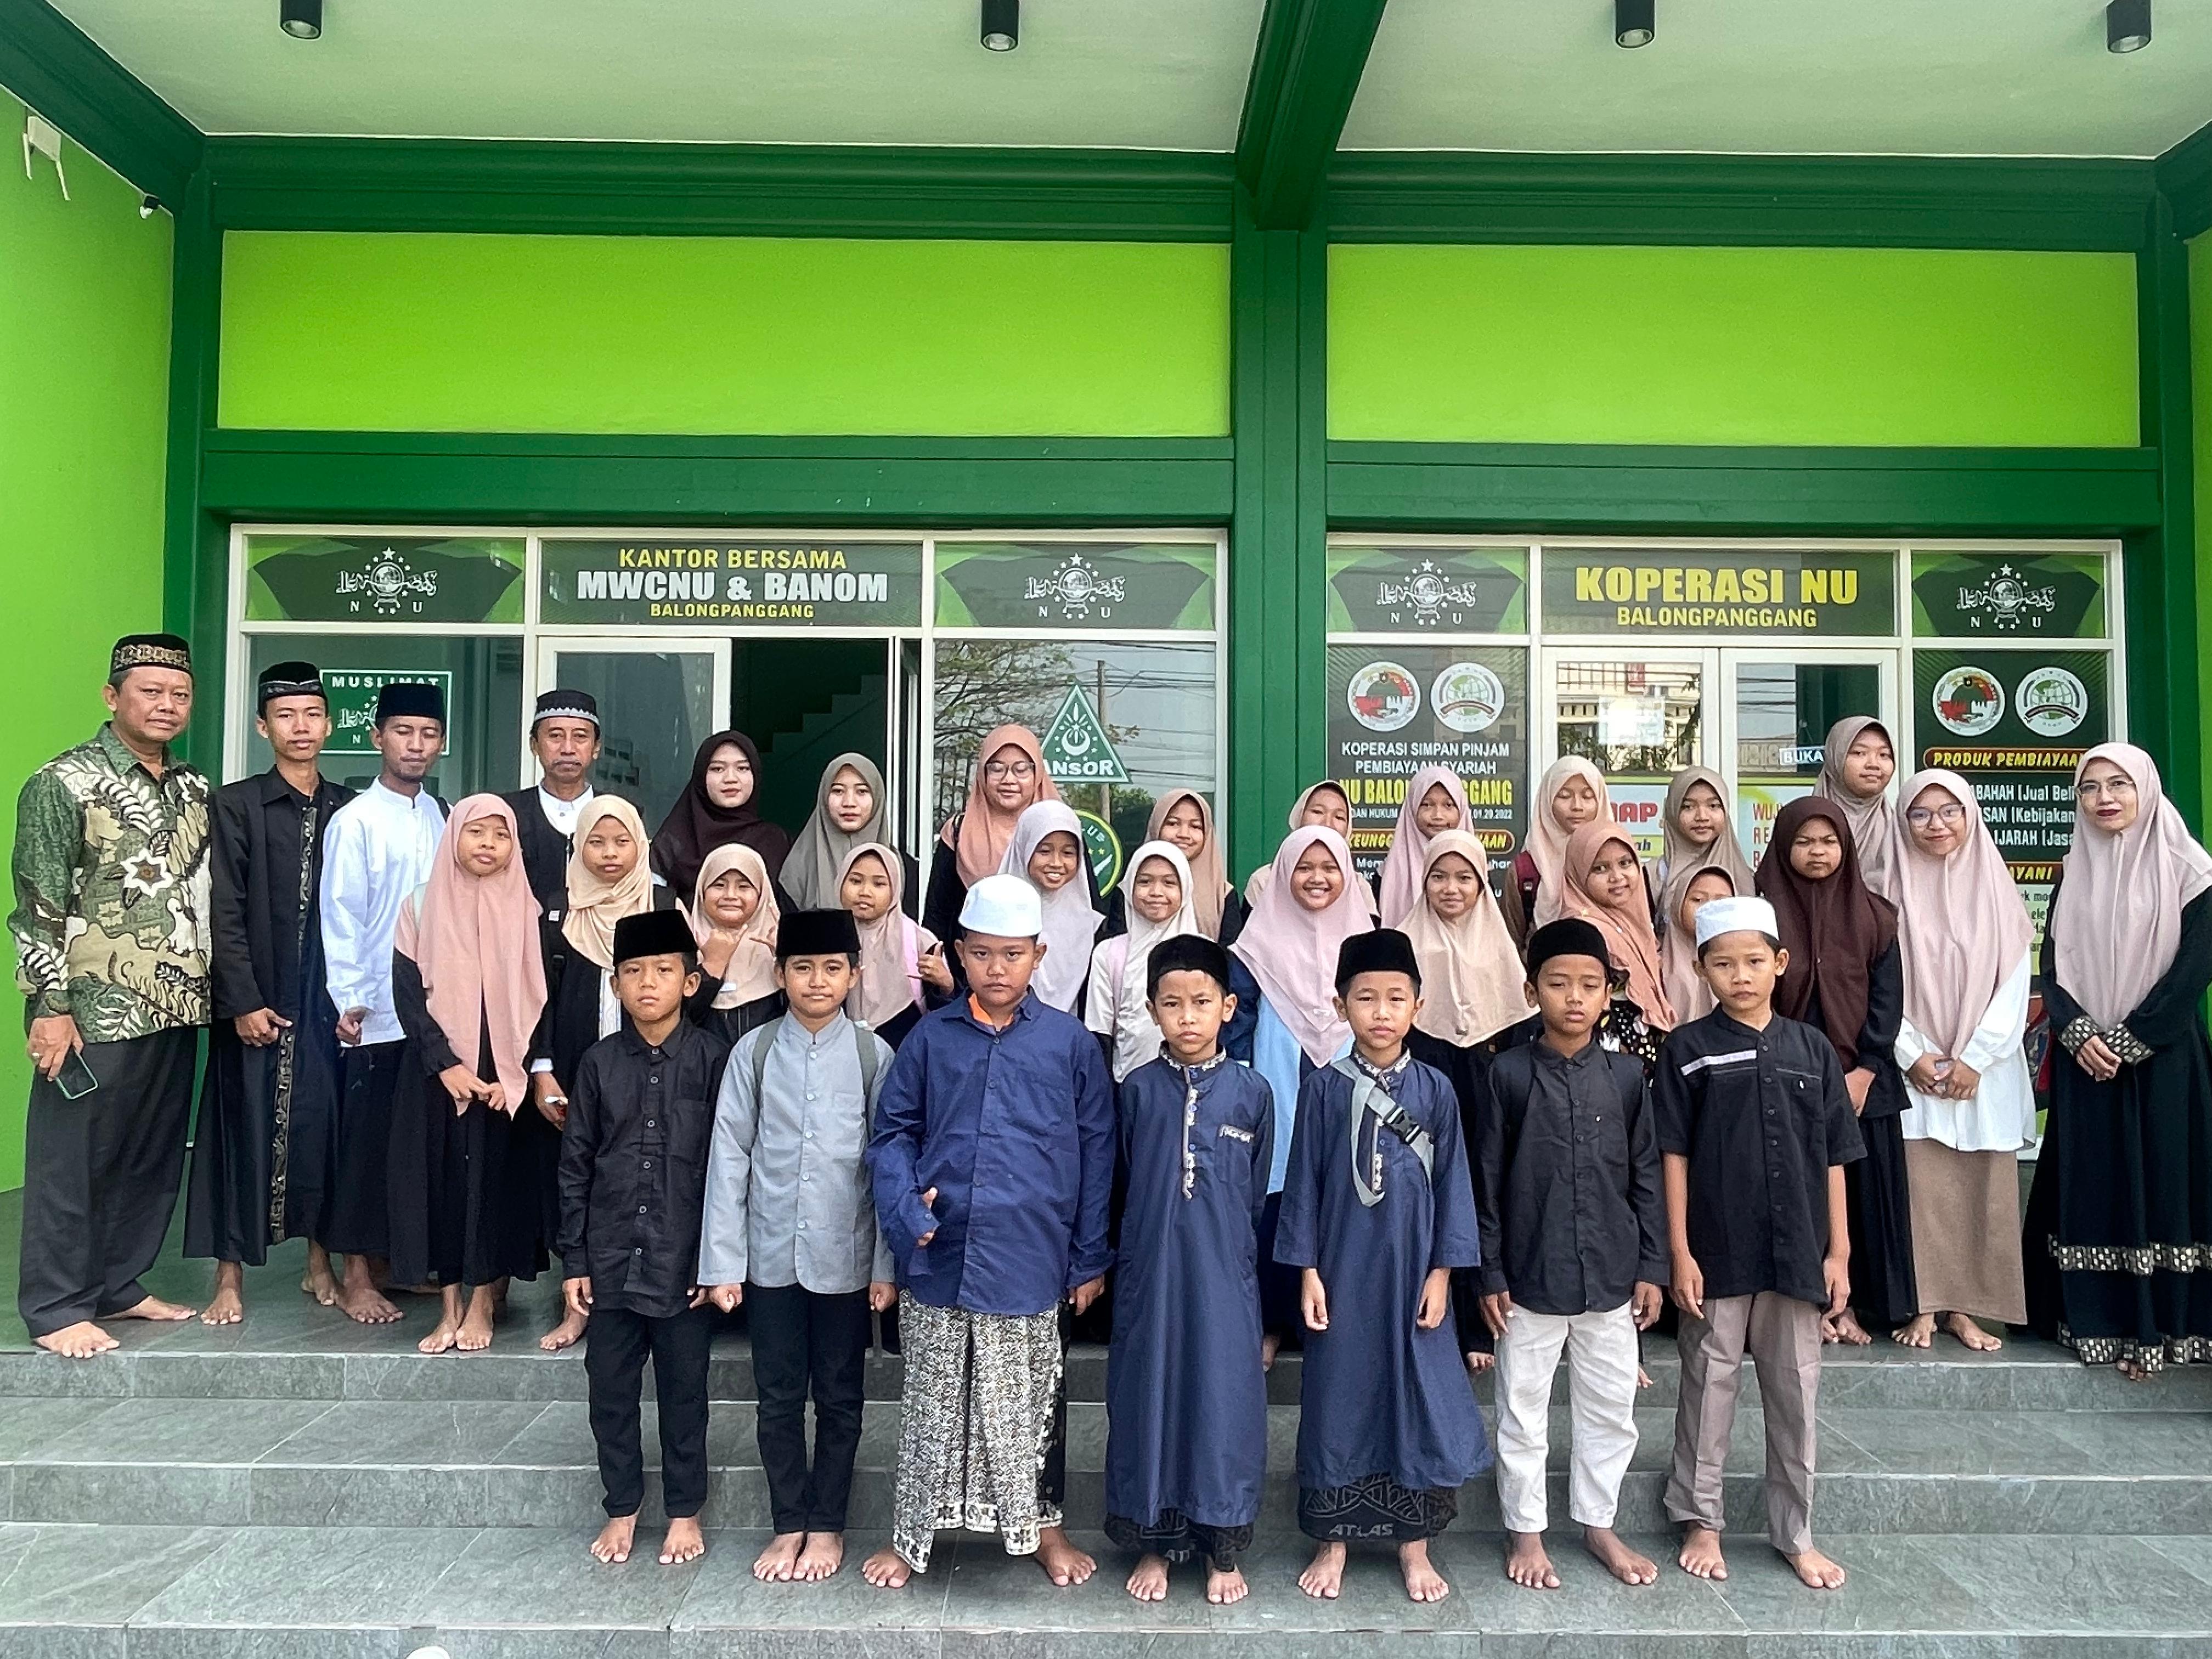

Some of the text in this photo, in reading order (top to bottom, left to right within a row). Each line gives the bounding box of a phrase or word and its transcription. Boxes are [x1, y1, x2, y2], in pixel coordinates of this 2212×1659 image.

[619, 549, 847, 569] KANTOR BERSAMA
[577, 571, 888, 602] MWCNU & BANOM
[1576, 566, 1858, 604] KOPERASI NU
[350, 600, 422, 612] N U
[650, 603, 814, 619] BALONGPANGGANG
[1039, 606, 1110, 618] N U
[1390, 612, 1462, 624] N U
[1617, 608, 1818, 627] BALONGPANGGANG
[1971, 616, 2042, 628] N U
[1341, 742, 1510, 757] KOPERASI SIMPAN PINJAM
[1784, 749, 1824, 763] BUKA
[1933, 752, 1993, 767] PRODUK
[1974, 785, 2015, 801] BAHAH
[1994, 830, 2038, 847] IJARAH
[1329, 1523, 1393, 1537] ATLAS
